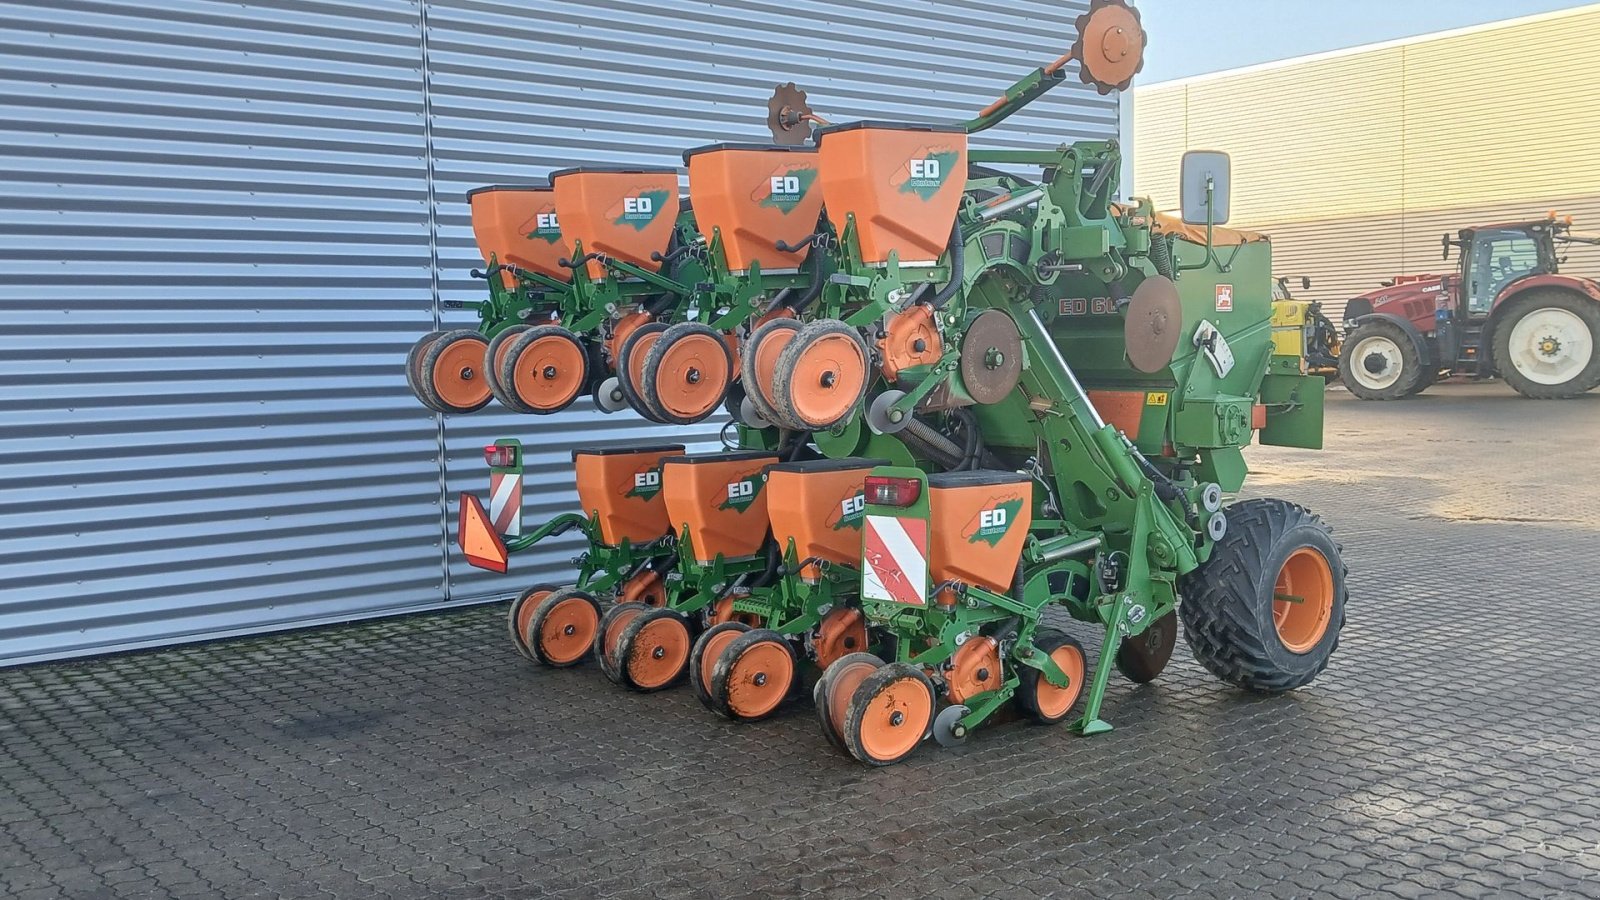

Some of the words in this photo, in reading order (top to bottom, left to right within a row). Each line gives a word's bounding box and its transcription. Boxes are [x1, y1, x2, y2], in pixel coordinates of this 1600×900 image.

[911, 160, 940, 178] ED
[771, 176, 800, 194] ED
[624, 197, 652, 213] ED
[1059, 298, 1087, 315] ED
[635, 471, 659, 487] ED
[728, 481, 753, 498] ED
[842, 494, 865, 515] ED
[981, 508, 1006, 528] ED
